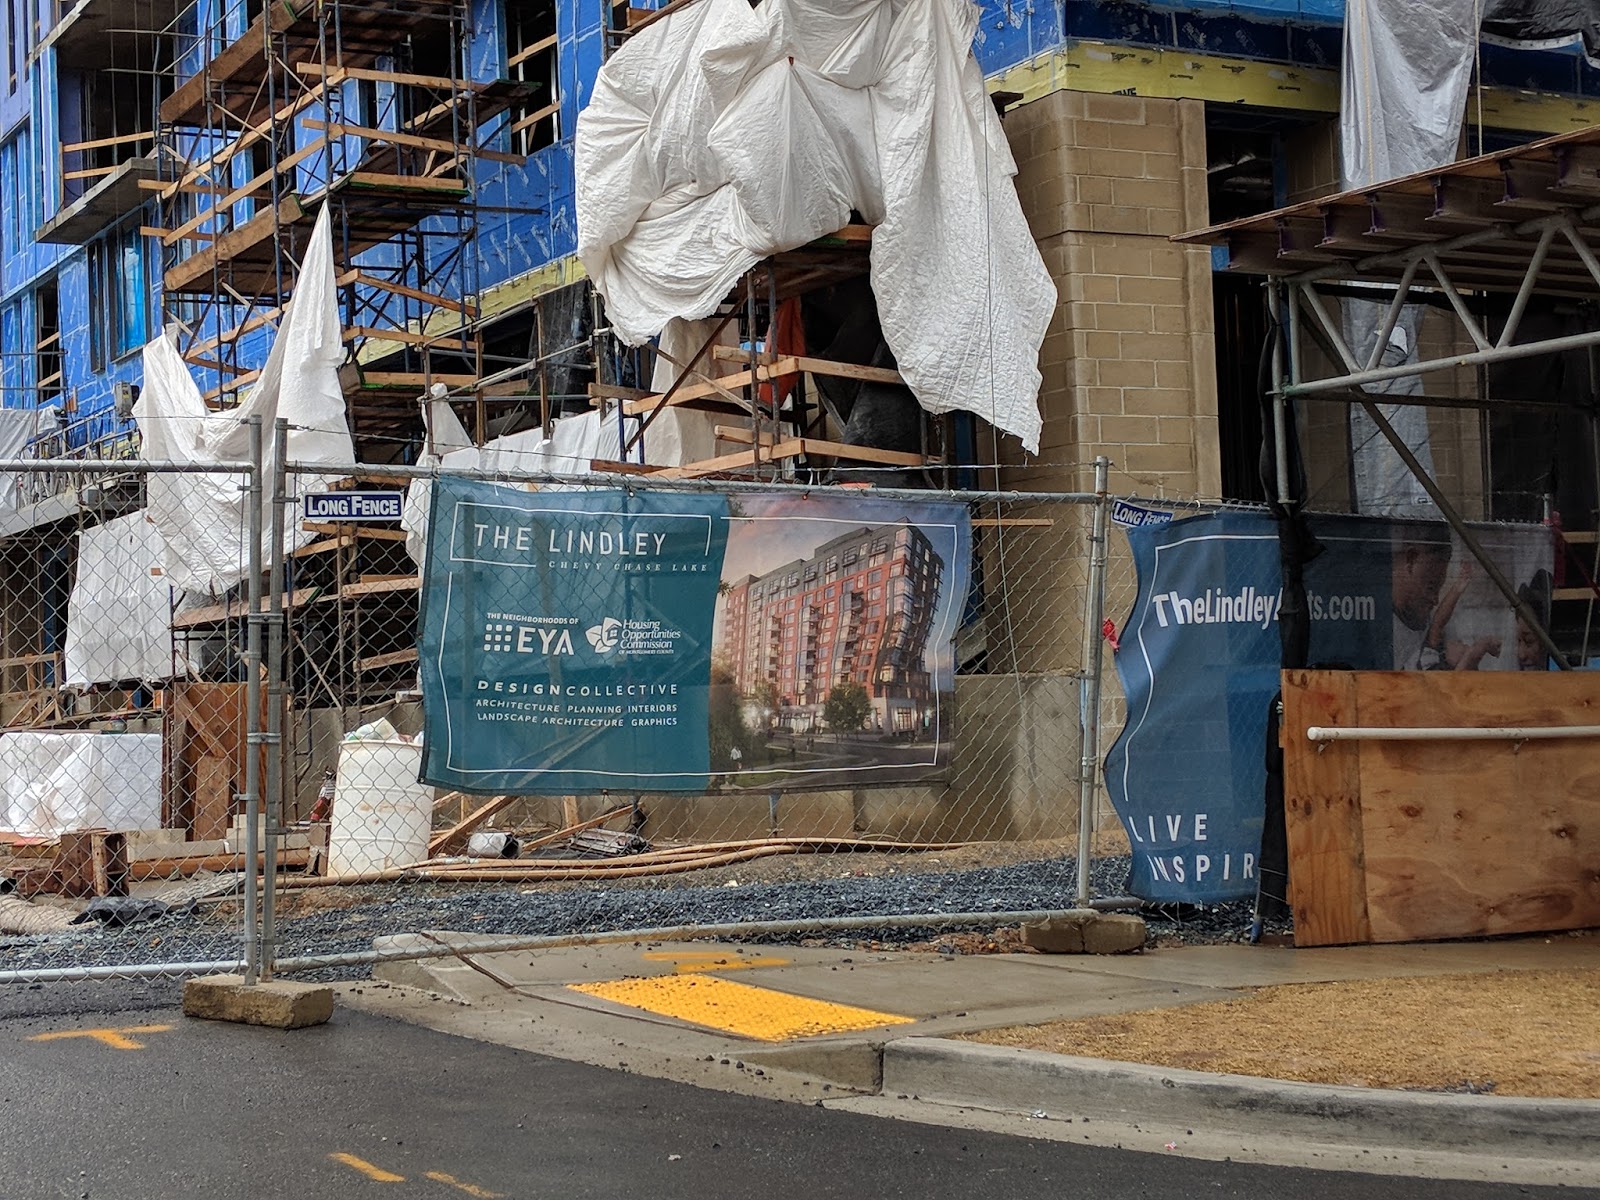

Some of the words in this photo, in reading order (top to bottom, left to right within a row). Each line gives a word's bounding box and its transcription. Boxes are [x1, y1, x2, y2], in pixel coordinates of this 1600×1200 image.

[307, 496, 349, 516] LONG
[351, 495, 399, 515] FENCE
[1113, 502, 1143, 525] LONG
[474, 523, 532, 551] THE
[549, 528, 667, 556] LINDLEY
[549, 560, 602, 570] CHEVY
[613, 562, 662, 572] CHASE
[672, 564, 708, 572] LAKE
[487, 612, 501, 620] THE
[502, 613, 568, 625] NEIGHBORHOODS
[569, 617, 580, 625] OF
[622, 618, 661, 632] Housing
[517, 626, 575, 656] EYA
[621, 629, 681, 642] Opportunities
[620, 639, 673, 649] Commission
[476, 699, 560, 713] ARCHITECTURE
[567, 704, 622, 714] PLANNING
[628, 703, 678, 713] INTERIORS
[477, 712, 538, 724] LANDSCAPE
[542, 716, 624, 727] ARCHITECTURE
[631, 717, 678, 727] GRAPHICS
[1128, 813, 1208, 843] LIVE
[1147, 852, 1255, 883] INSPIR
